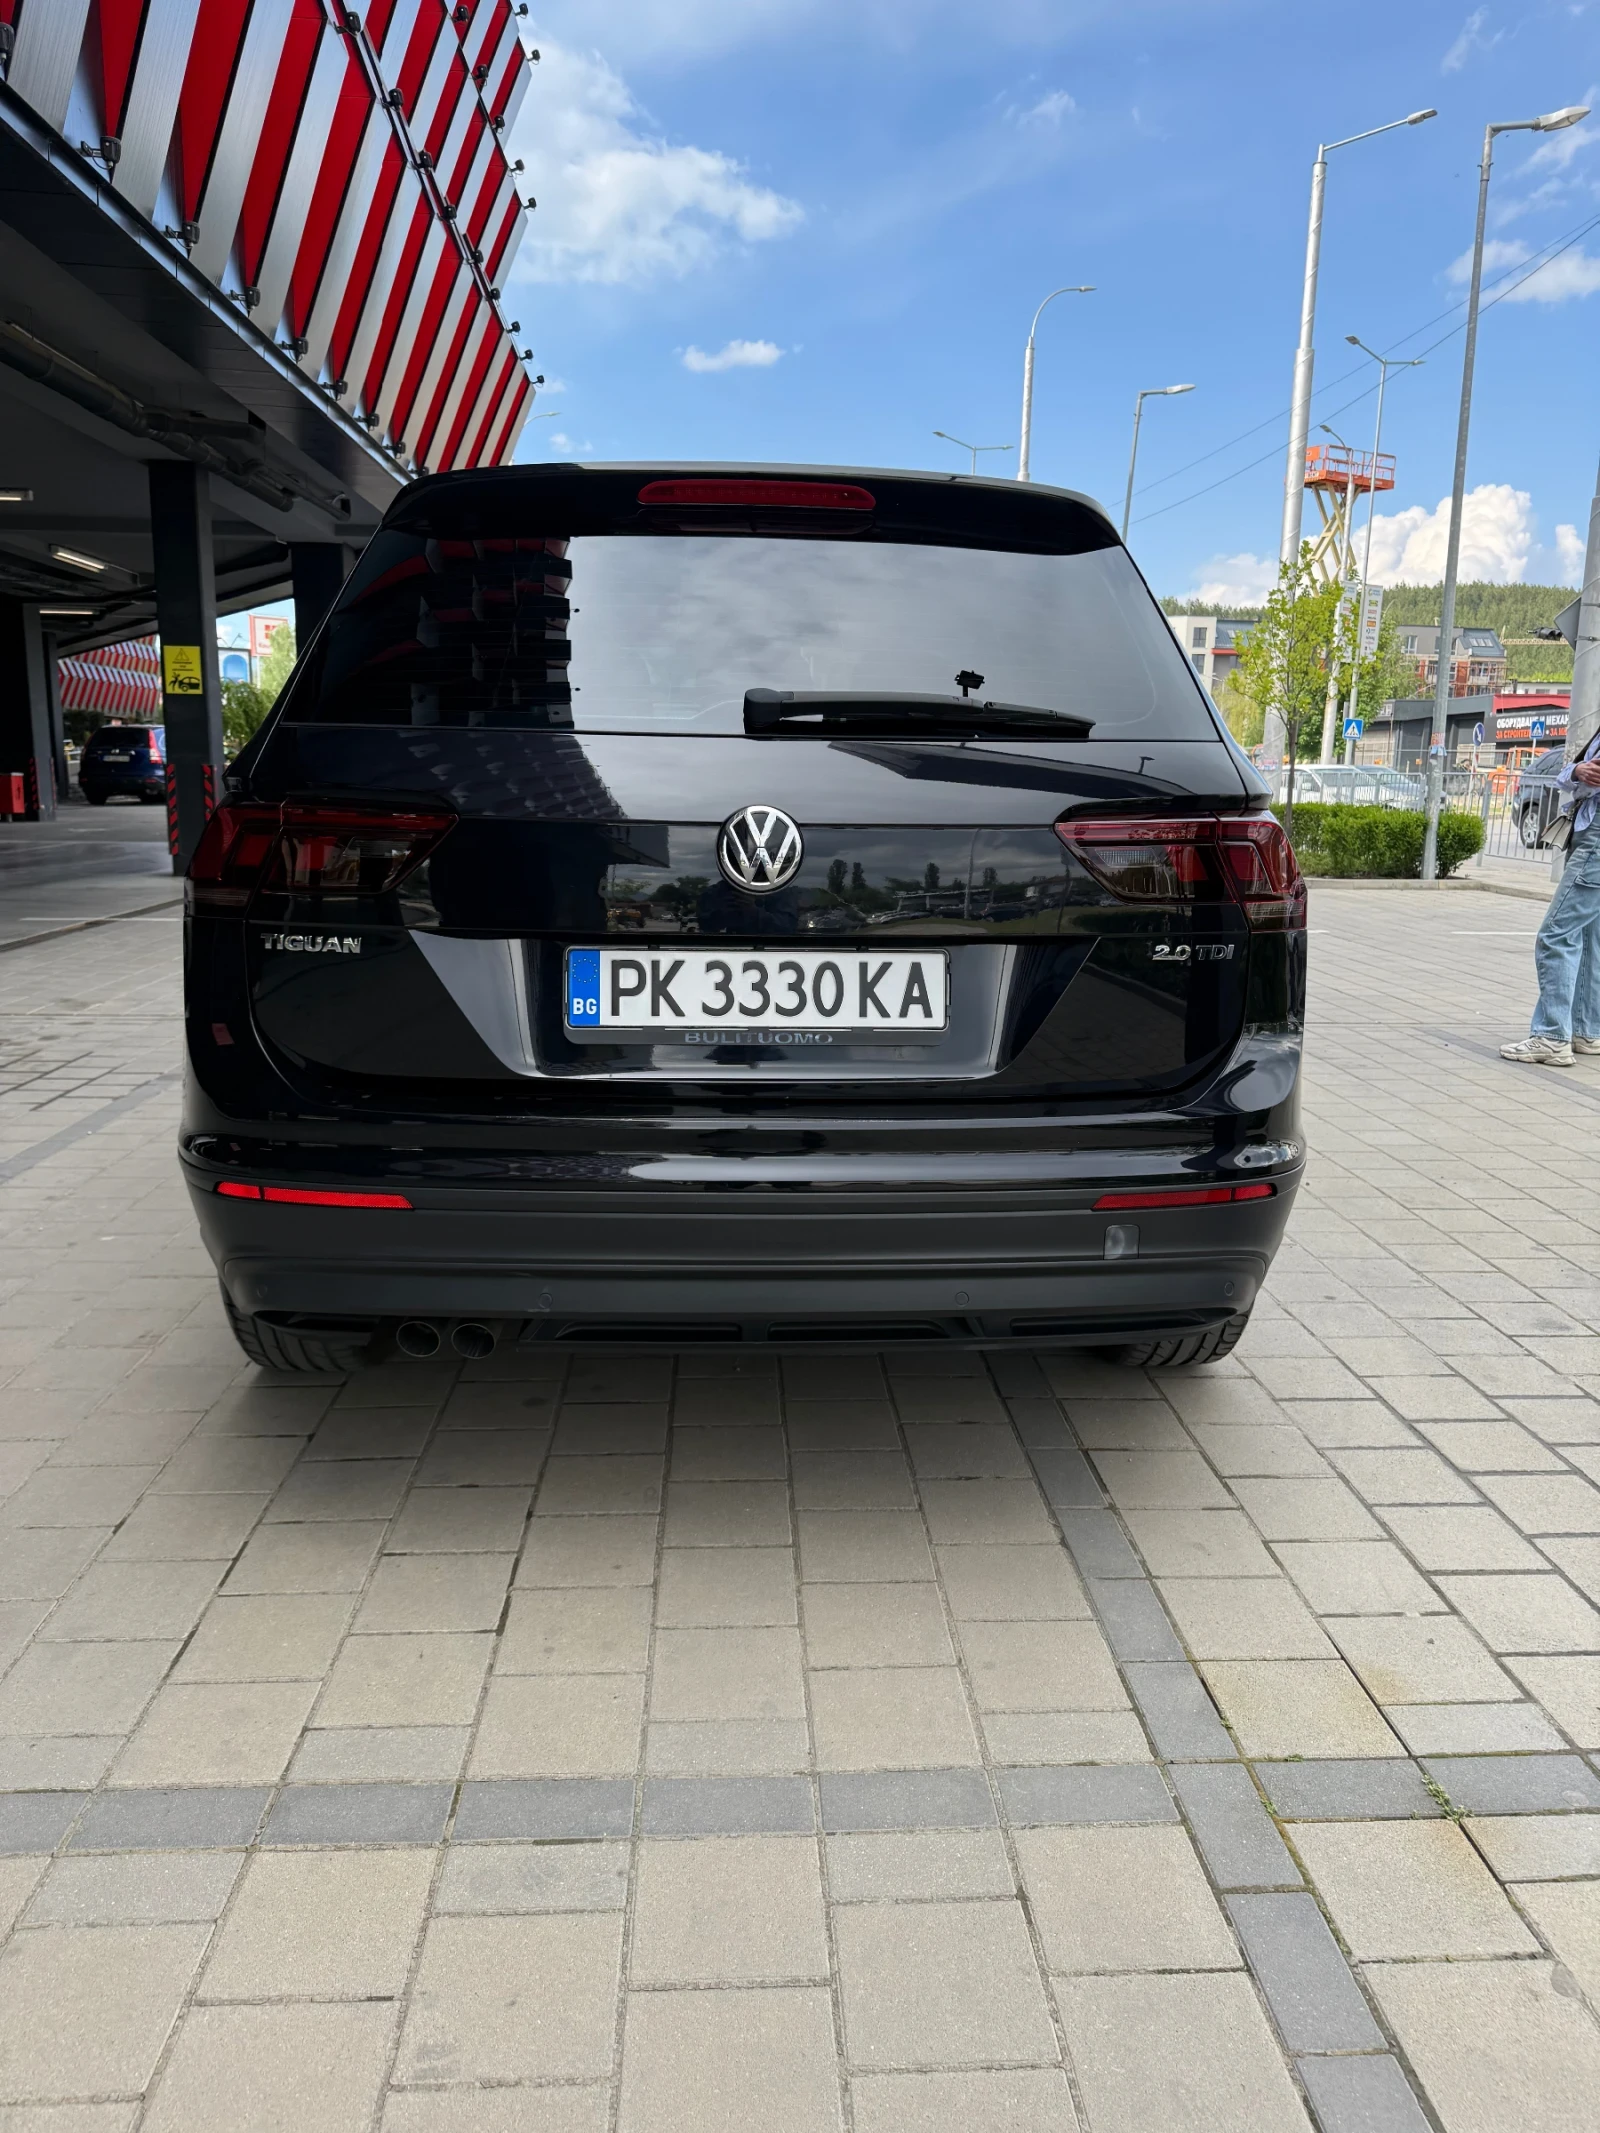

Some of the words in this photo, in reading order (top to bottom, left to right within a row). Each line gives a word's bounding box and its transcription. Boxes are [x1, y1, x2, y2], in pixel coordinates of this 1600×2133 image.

[260, 932, 362, 954] TIGUAN
[1195, 944, 1235, 961] TDI
[611, 959, 686, 1017] PK
[701, 960, 845, 1018] 3330
[858, 961, 933, 1018] KA
[572, 998, 597, 1015] BG
